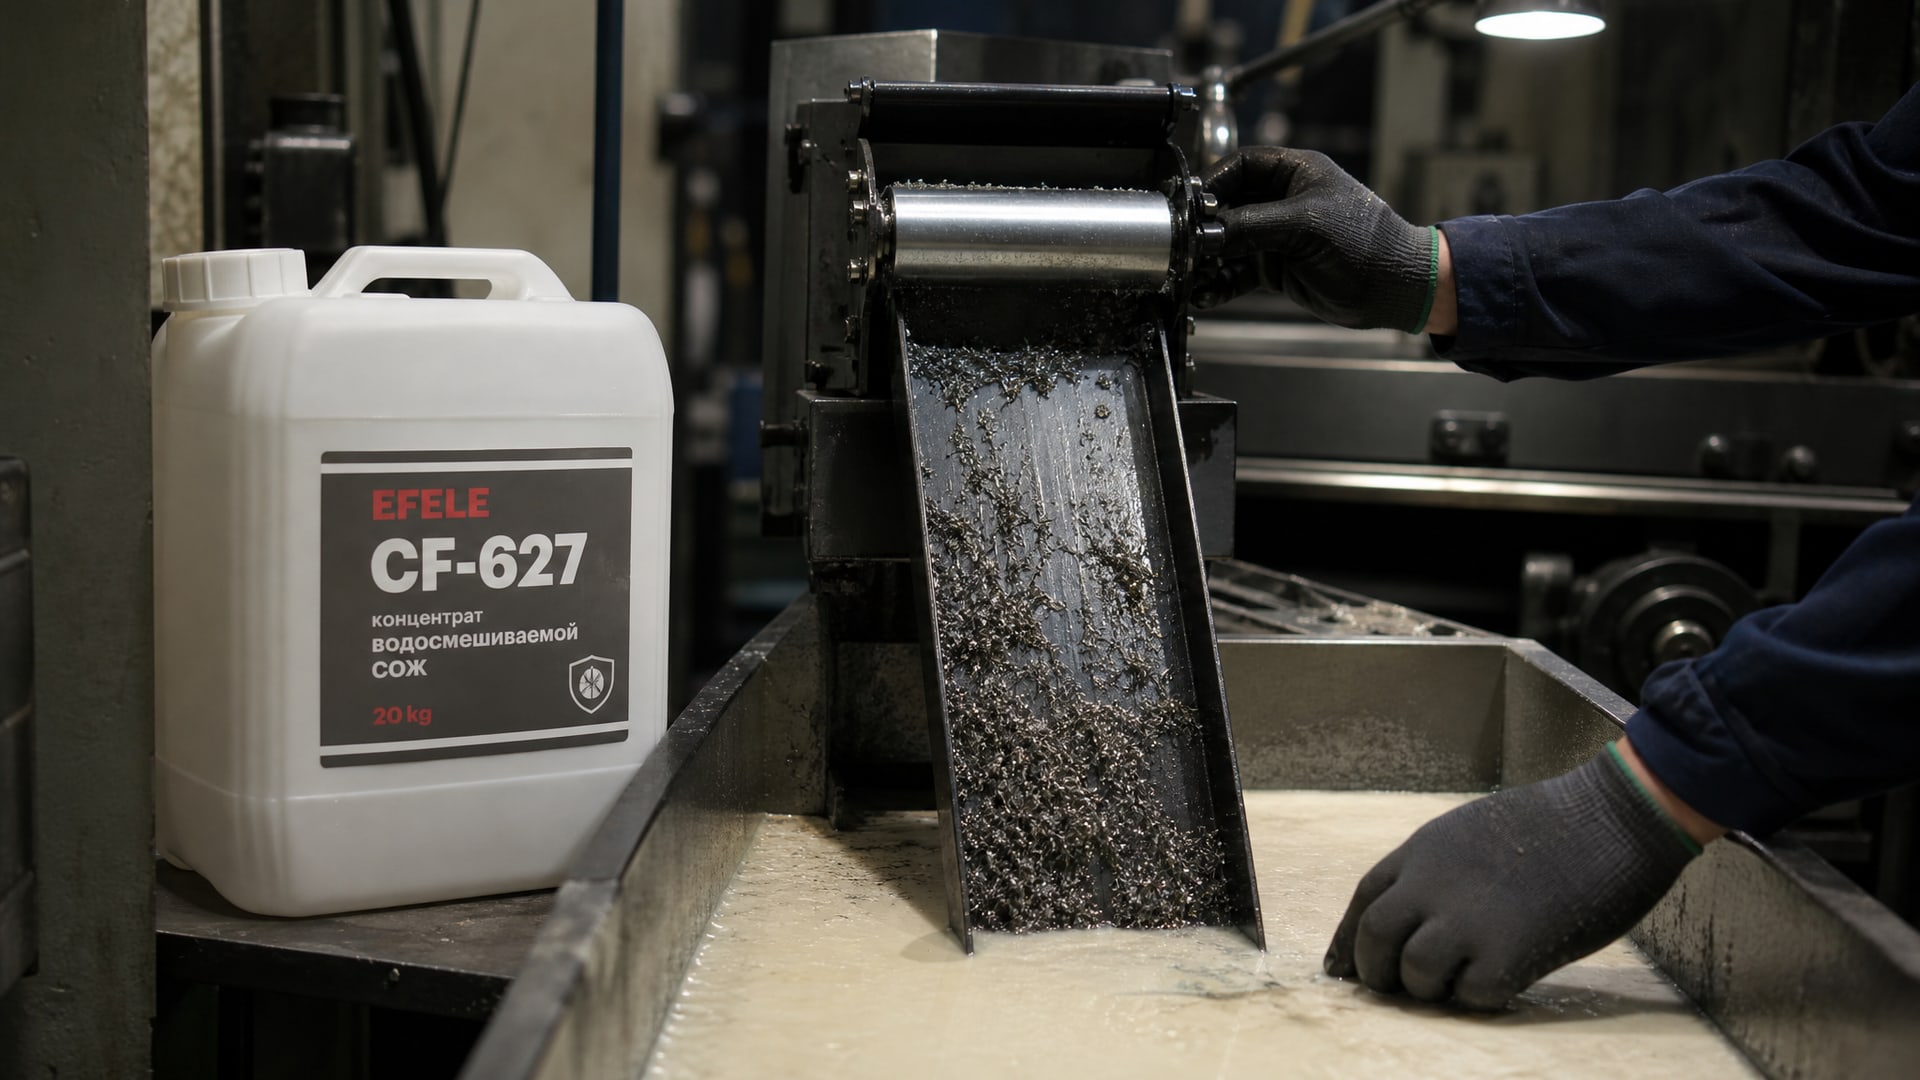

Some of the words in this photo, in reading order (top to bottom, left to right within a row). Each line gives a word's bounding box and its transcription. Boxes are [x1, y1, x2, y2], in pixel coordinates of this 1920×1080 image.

[372, 488, 489, 520] EFELE
[371, 532, 588, 593] CF-627
[372, 610, 483, 628] концентрат
[372, 622, 578, 654] водосмешиваемой
[373, 707, 403, 725] 20
[406, 705, 432, 726] kg
